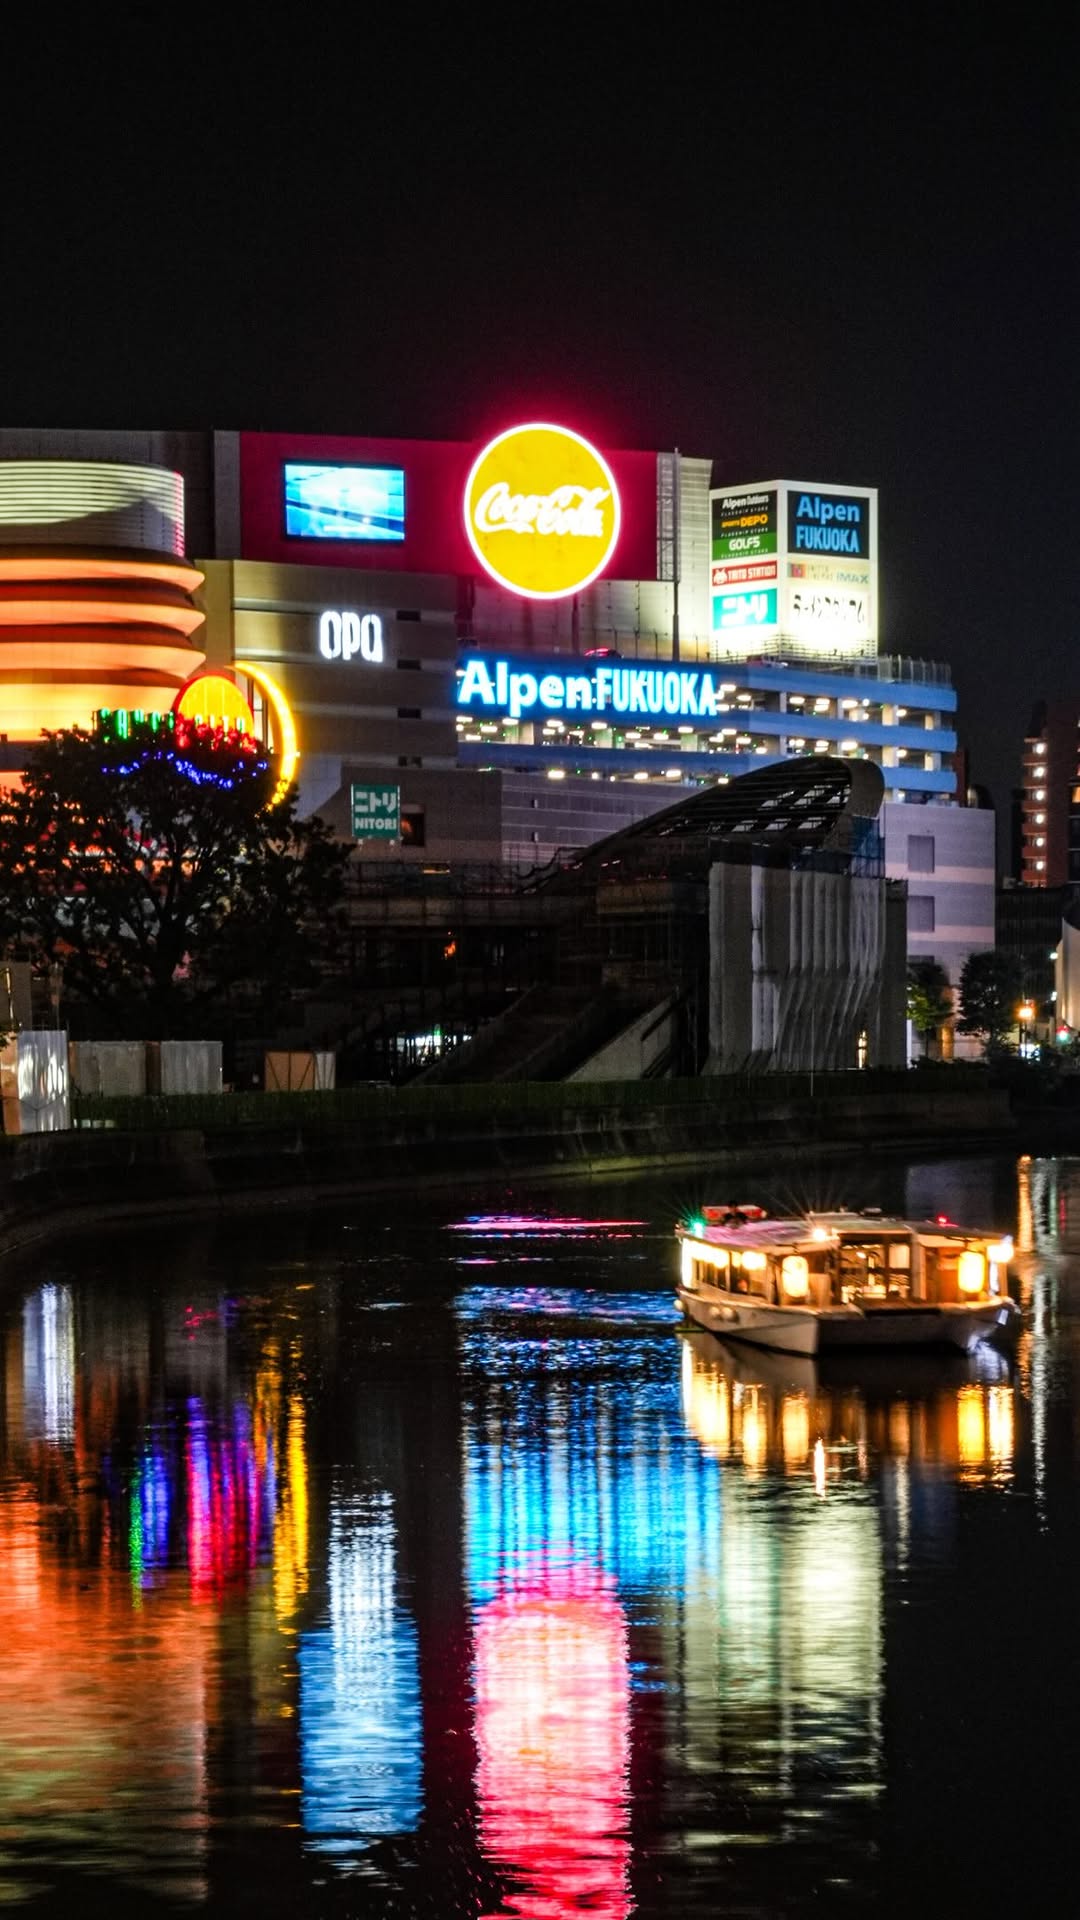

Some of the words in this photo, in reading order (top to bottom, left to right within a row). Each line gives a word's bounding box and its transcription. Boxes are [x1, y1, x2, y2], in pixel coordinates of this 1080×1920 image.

[722, 498, 747, 510] Alpen
[796, 496, 860, 525] Alpen
[740, 514, 768, 527] DEPO
[796, 526, 860, 554] FUKUOKA
[748, 565, 776, 579] STATION
[457, 659, 593, 717] Alpen
[595, 667, 717, 716] FUKUOKA
[354, 791, 397, 814] ニトリ
[354, 818, 397, 831] NITORI
